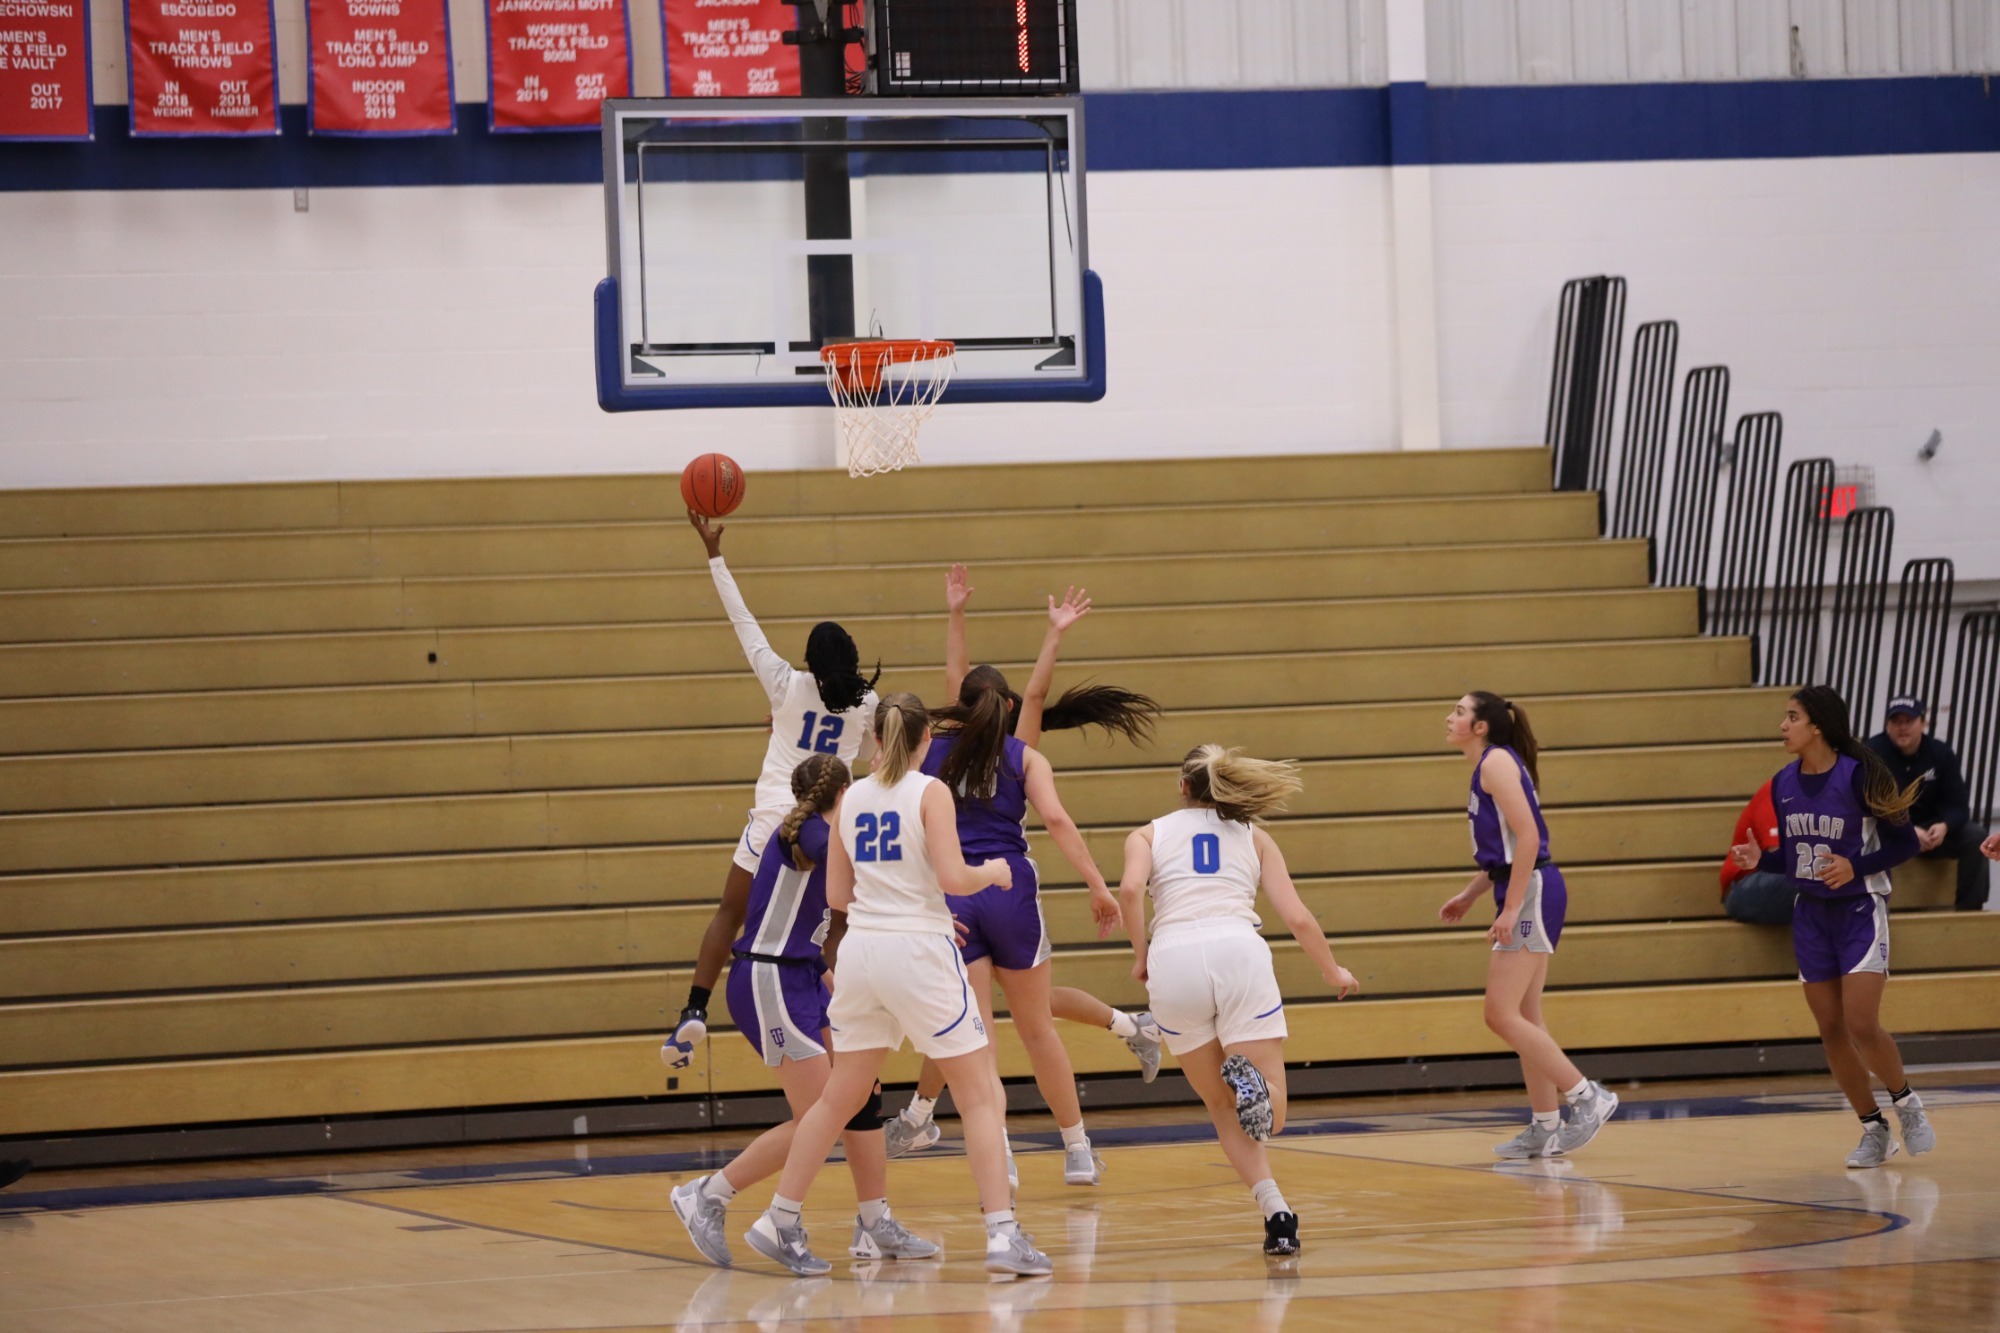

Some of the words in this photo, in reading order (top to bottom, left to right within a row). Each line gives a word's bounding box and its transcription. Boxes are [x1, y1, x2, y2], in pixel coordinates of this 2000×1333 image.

[161, 4, 236, 16] ESCOBEDO
[349, 4, 400, 16] DOWNS
[496, 0, 575, 12] JANKOWSKI
[527, 23, 589, 36] WOMEN'S
[707, 18, 750, 32] MEN'S
[0, 31, 47, 43] MEN'S
[179, 30, 221, 42] MEN'S
[354, 29, 397, 41] MEN'S
[682, 31, 725, 45] TRACK
[729, 31, 738, 44] &
[741, 29, 780, 43] FIELD
[149, 42, 196, 55] TRACK
[200, 43, 209, 55] &
[214, 42, 254, 55] FIELD
[326, 41, 372, 54] TRACK
[376, 42, 385, 54] &
[389, 41, 429, 54] FIELD
[508, 37, 554, 50] TRACK
[558, 37, 567, 49] &
[570, 35, 609, 49] FIELD
[12, 45, 22, 56] &
[27, 44, 67, 57] FIELD
[693, 44, 730, 58] LONG
[732, 43, 769, 57] JUMP
[12, 58, 56, 70] VAULT
[172, 55, 232, 68] THROWS
[338, 55, 376, 68] LONG
[379, 55, 417, 68] JUMP
[575, 73, 605, 87] OUT
[697, 70, 712, 82] IN
[747, 67, 776, 81] OUT
[165, 81, 179, 93] IN
[220, 81, 248, 93] OUT
[352, 80, 405, 93] INDOOR
[524, 75, 539, 88] IN
[747, 80, 779, 94] 2022
[31, 84, 61, 96] OUT
[516, 88, 549, 102] 2019
[577, 86, 607, 100] 2021
[30, 97, 63, 109] 2017
[158, 94, 188, 106] 2018
[219, 94, 250, 106] 2018
[364, 93, 395, 106] 2018
[153, 107, 193, 117] WEIGHT
[211, 106, 258, 117] HAMMER
[365, 106, 396, 119] 2019
[797, 711, 845, 755] 12
[1785, 813, 1844, 840] TAYLOR
[855, 811, 902, 862] 22
[1192, 833, 1220, 874] 0
[1795, 842, 1832, 881] 22
